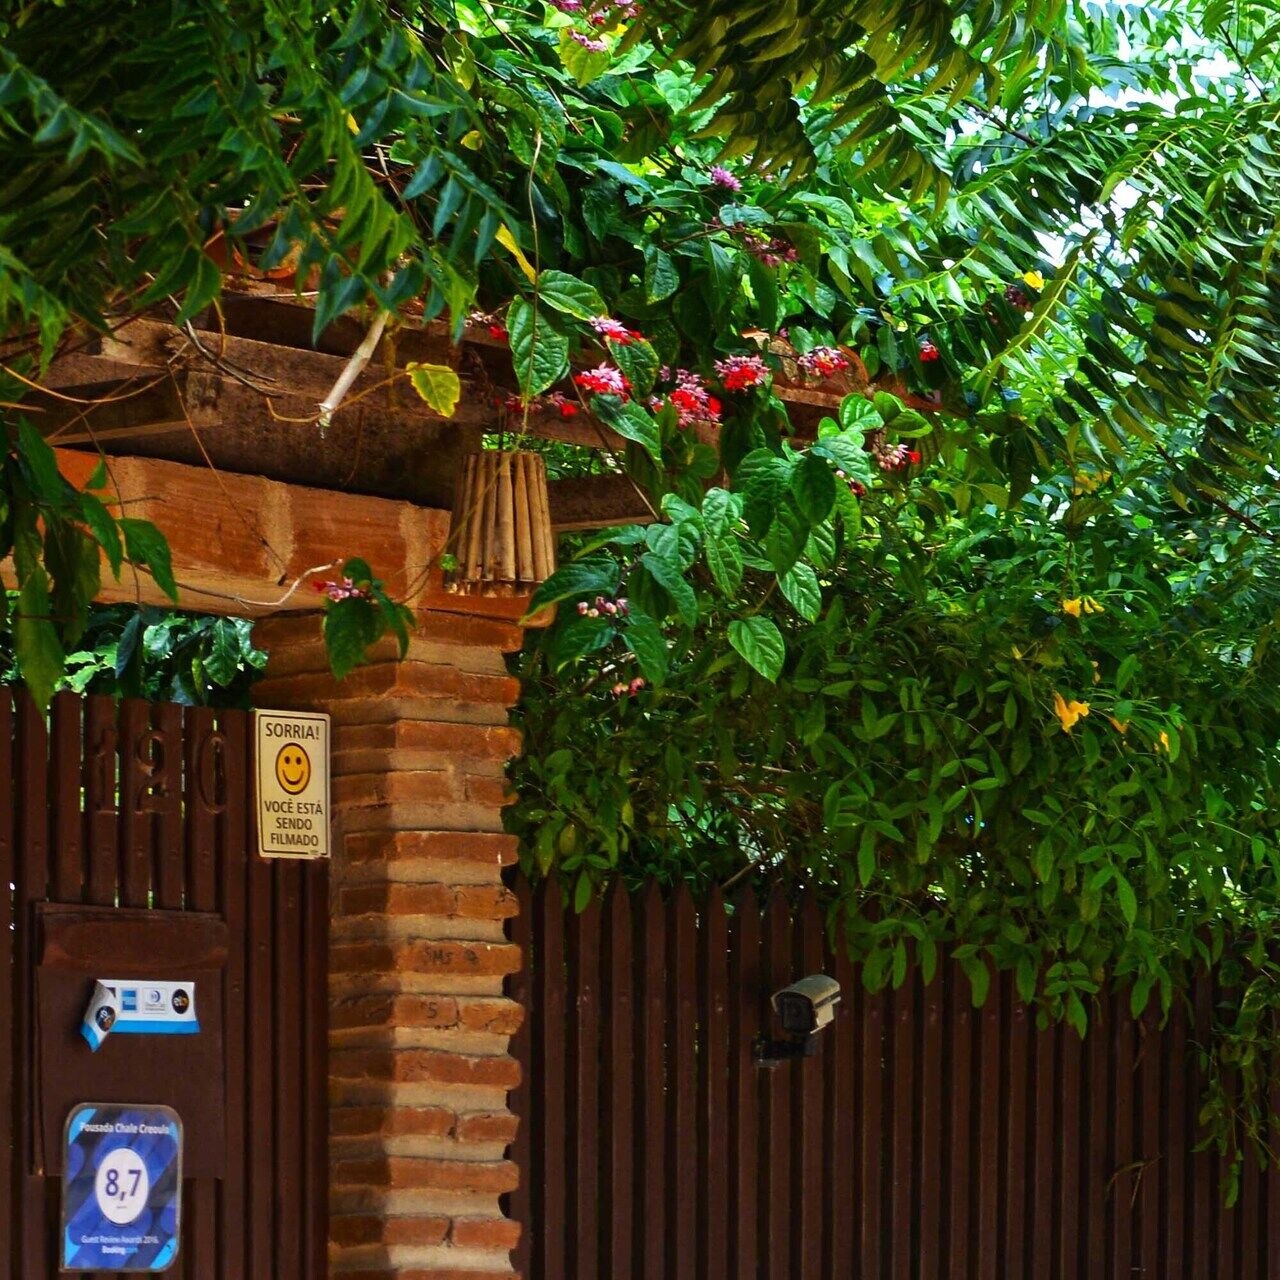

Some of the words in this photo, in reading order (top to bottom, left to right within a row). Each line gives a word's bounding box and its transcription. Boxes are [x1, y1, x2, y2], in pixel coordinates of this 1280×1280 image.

[265, 722, 320, 740] SORRIA!
[264, 798, 294, 814] VOCÊ
[296, 799, 324, 815] ESTÁ
[275, 817, 313, 830] SENDO
[270, 833, 319, 847] FILMADO
[106, 1169, 142, 1201] 8,7
